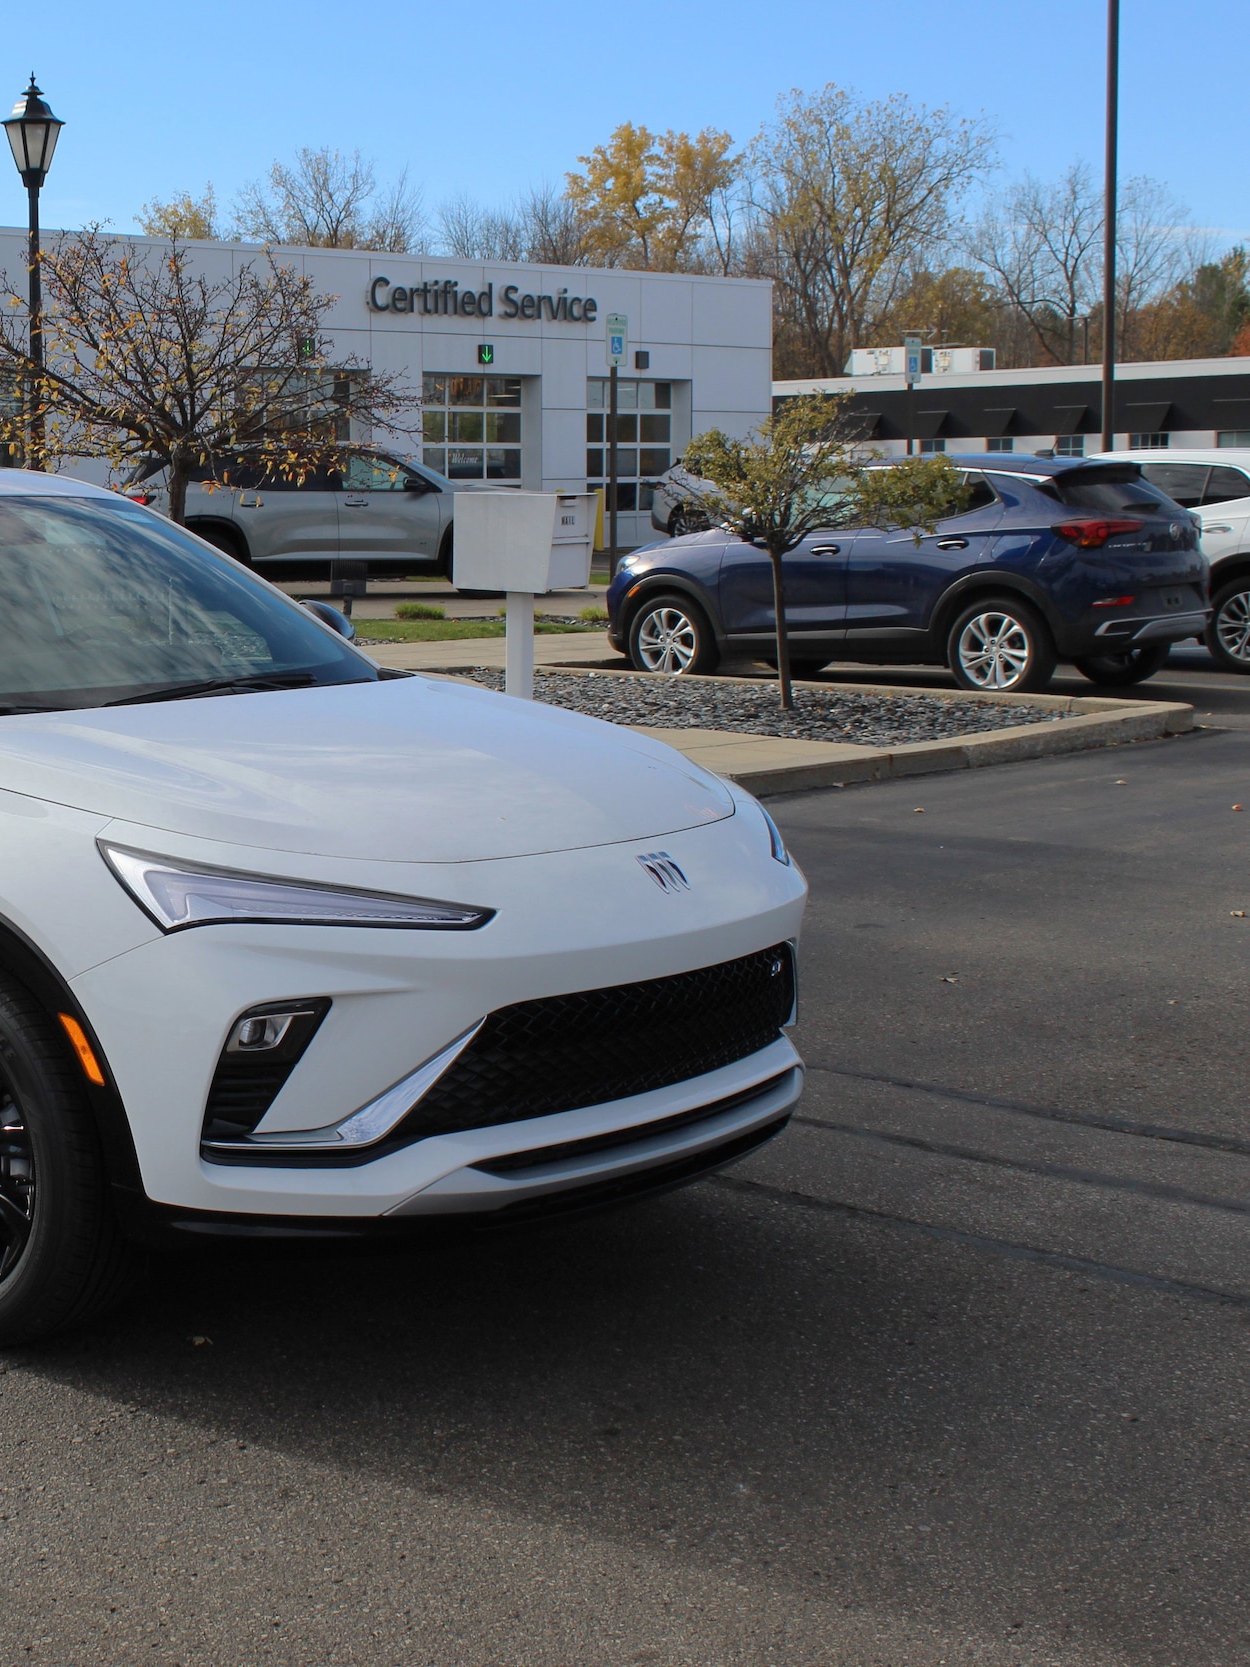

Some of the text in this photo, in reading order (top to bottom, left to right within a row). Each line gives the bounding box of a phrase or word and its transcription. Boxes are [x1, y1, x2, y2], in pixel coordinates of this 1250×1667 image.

[367, 276, 597, 323] Certified Service
[452, 453, 479, 464] Welcome
